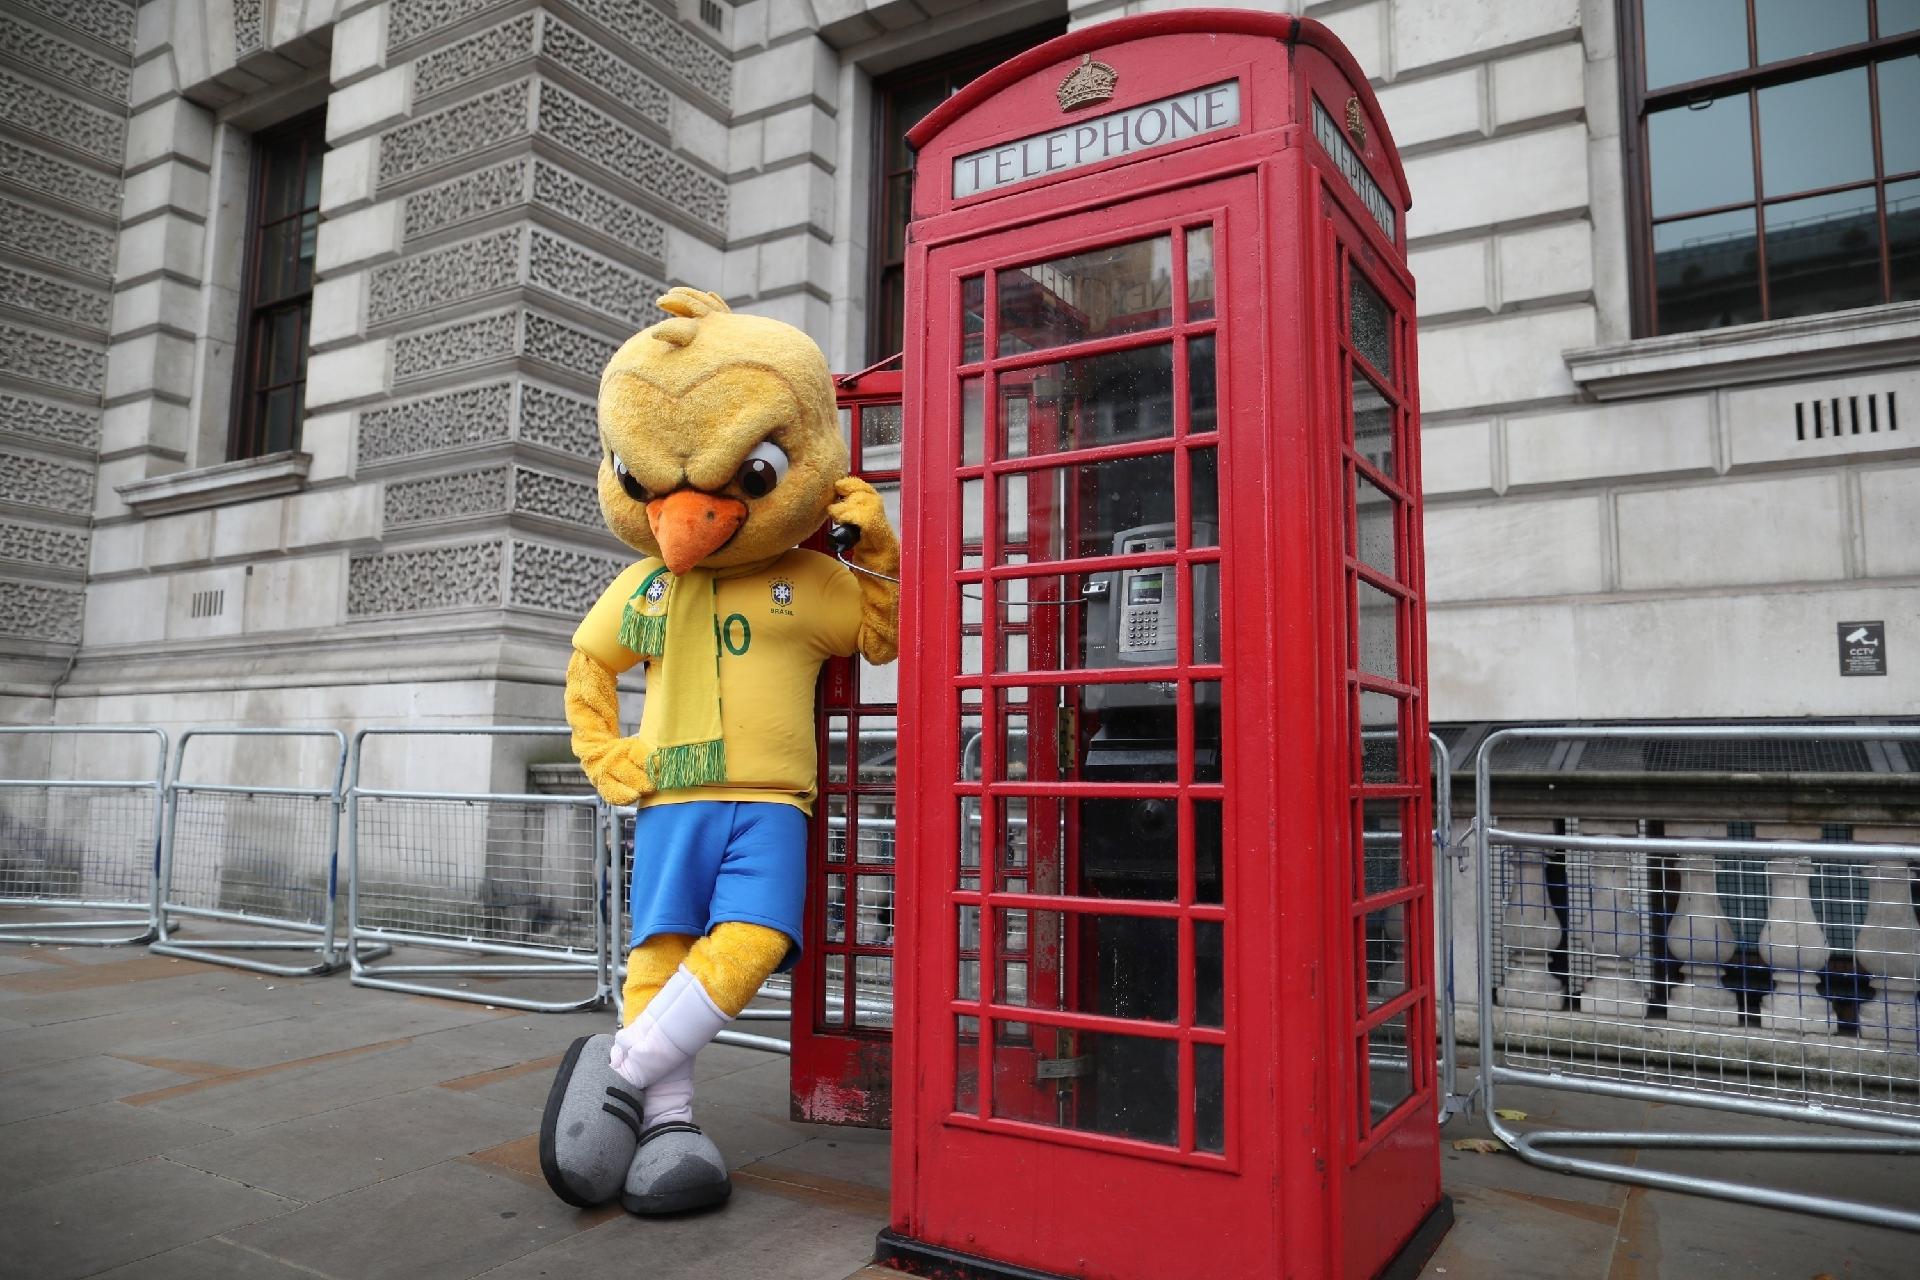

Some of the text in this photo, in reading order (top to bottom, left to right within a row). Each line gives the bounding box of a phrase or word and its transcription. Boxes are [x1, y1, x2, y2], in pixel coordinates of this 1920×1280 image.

[964, 88, 1230, 191] TELEPHONE
[1314, 104, 1393, 239] TELEPHONE
[770, 608, 794, 616] BRASIL
[1850, 647, 1875, 655] CCTV
